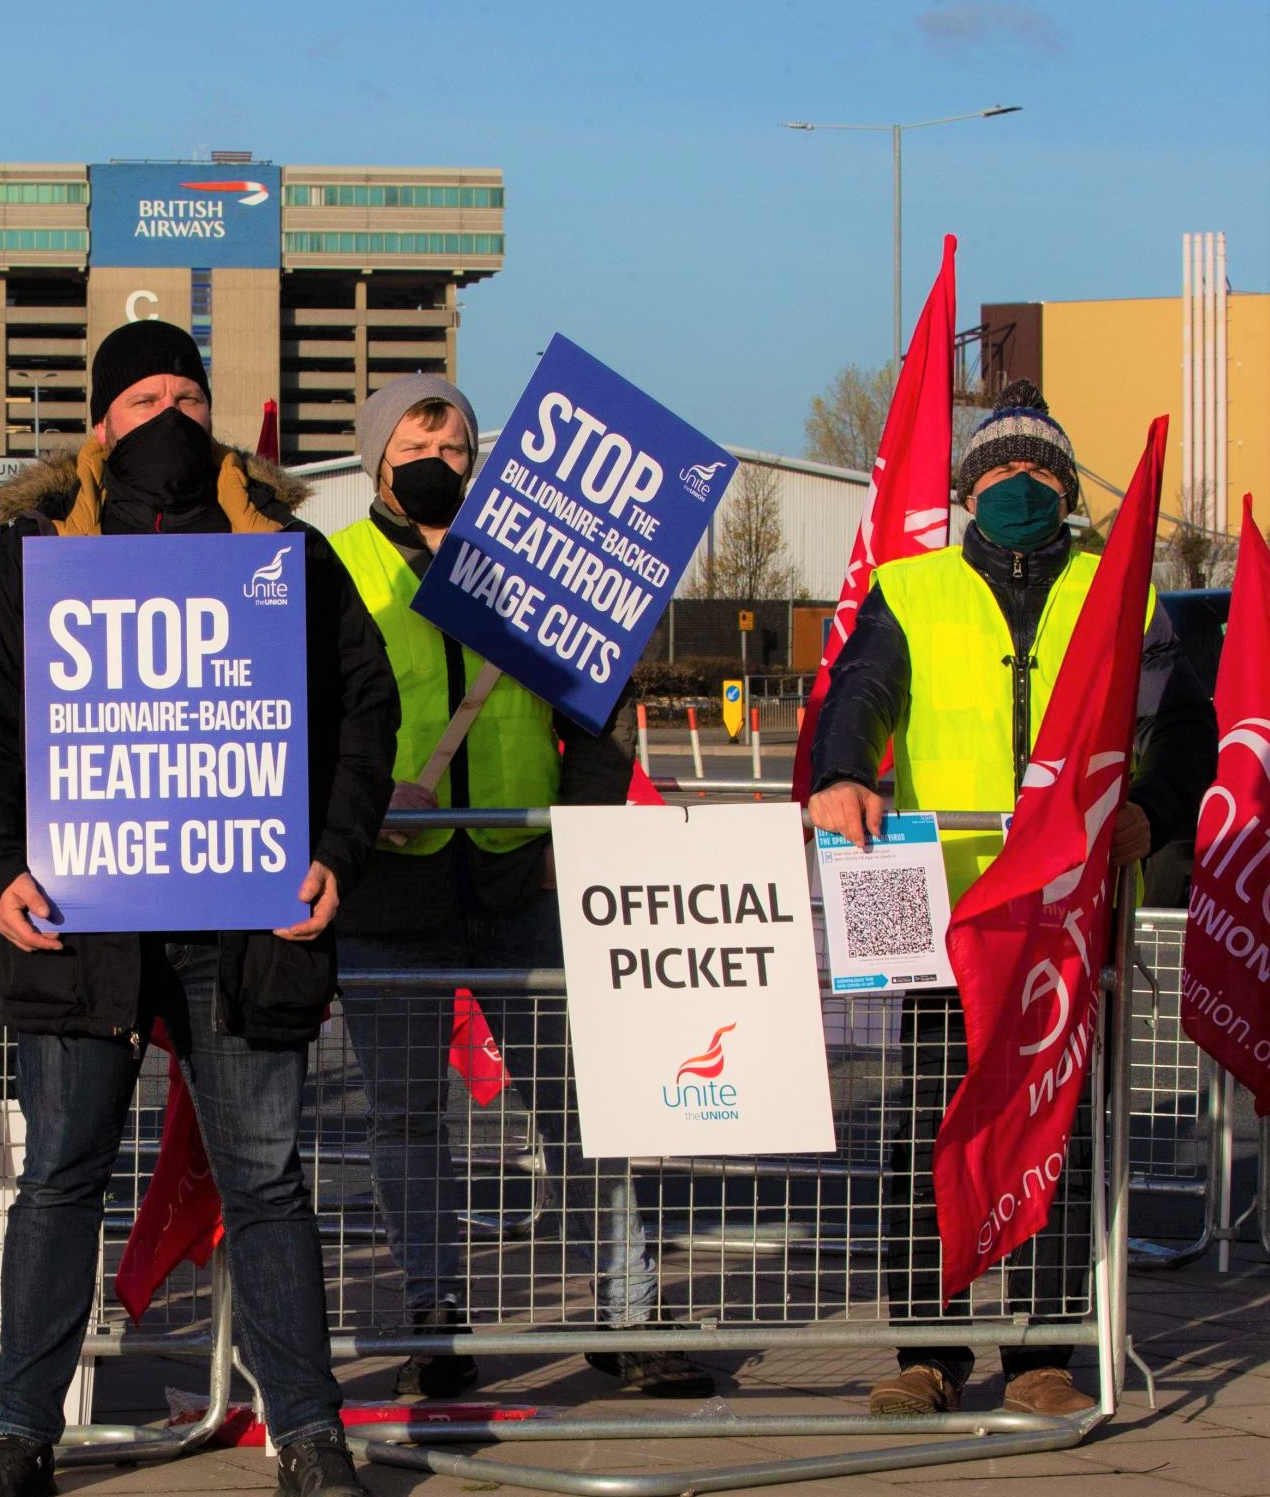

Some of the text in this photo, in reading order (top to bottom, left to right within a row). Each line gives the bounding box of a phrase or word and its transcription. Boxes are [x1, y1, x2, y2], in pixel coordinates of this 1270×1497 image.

[134, 220, 226, 238] AIRWAYS
[139, 200, 223, 217] BRITISH
[125, 290, 159, 323] C
[520, 392, 664, 541] STOP THE
[679, 468, 710, 496] unite
[499, 458, 670, 589] BILLIONAIRE-BACKED
[474, 488, 653, 632] HEATHROW
[243, 580, 288, 598] unite
[448, 540, 621, 685] WAGE CUTS
[49, 597, 252, 691] STOP THE
[49, 700, 292, 734] BILLIONAIRE-BACKED
[49, 742, 288, 800] HEATHROW
[49, 818, 287, 876] WAGE CUTS
[581, 882, 794, 927] OFFICIAL
[609, 946, 775, 990] PICKET
[663, 1081, 737, 1108] unite
[685, 1110, 739, 1121] theUNION
